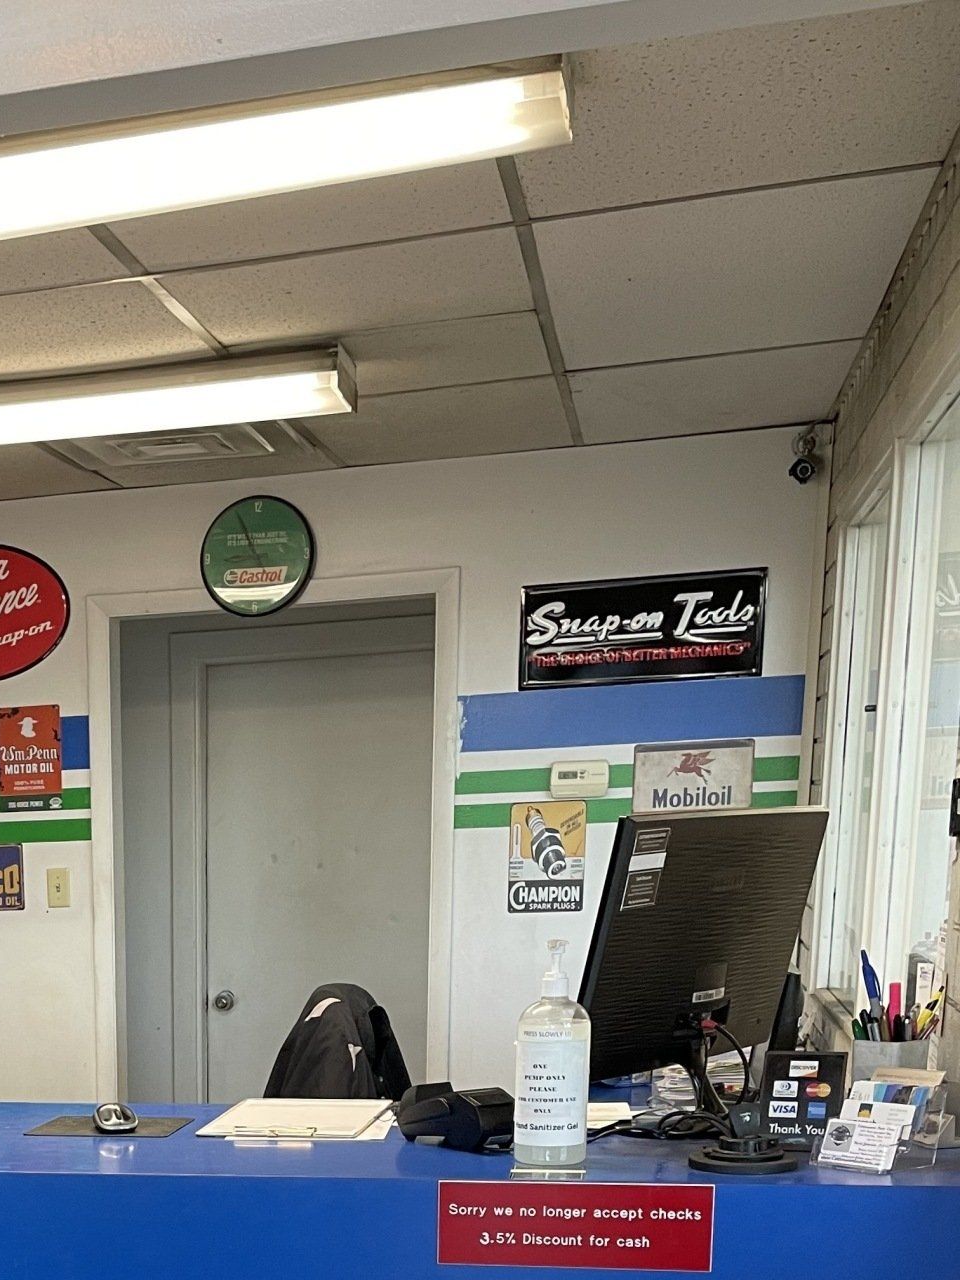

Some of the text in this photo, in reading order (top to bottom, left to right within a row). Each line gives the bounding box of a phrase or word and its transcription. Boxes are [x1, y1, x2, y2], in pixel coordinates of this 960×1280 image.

[239, 569, 283, 585] Castrol
[525, 589, 756, 646] Snap-on Tools
[26, 744, 58, 761] Penn
[4, 762, 54, 775] MOTOR OIL
[652, 785, 732, 809] Mobiloil
[6, 895, 21, 906] OIL
[509, 881, 581, 911] CHAMPION
[553, 902, 576, 910] PLUGS
[771, 1104, 796, 1114] VISA
[529, 1123, 565, 1131] Sanitizer
[566, 1121, 579, 1130] Gel
[769, 1122, 825, 1135] Thank You
[448, 1203, 702, 1221] Sorry we no longer accept checks
[479, 1231, 650, 1248] 3.5% Discount for cash
